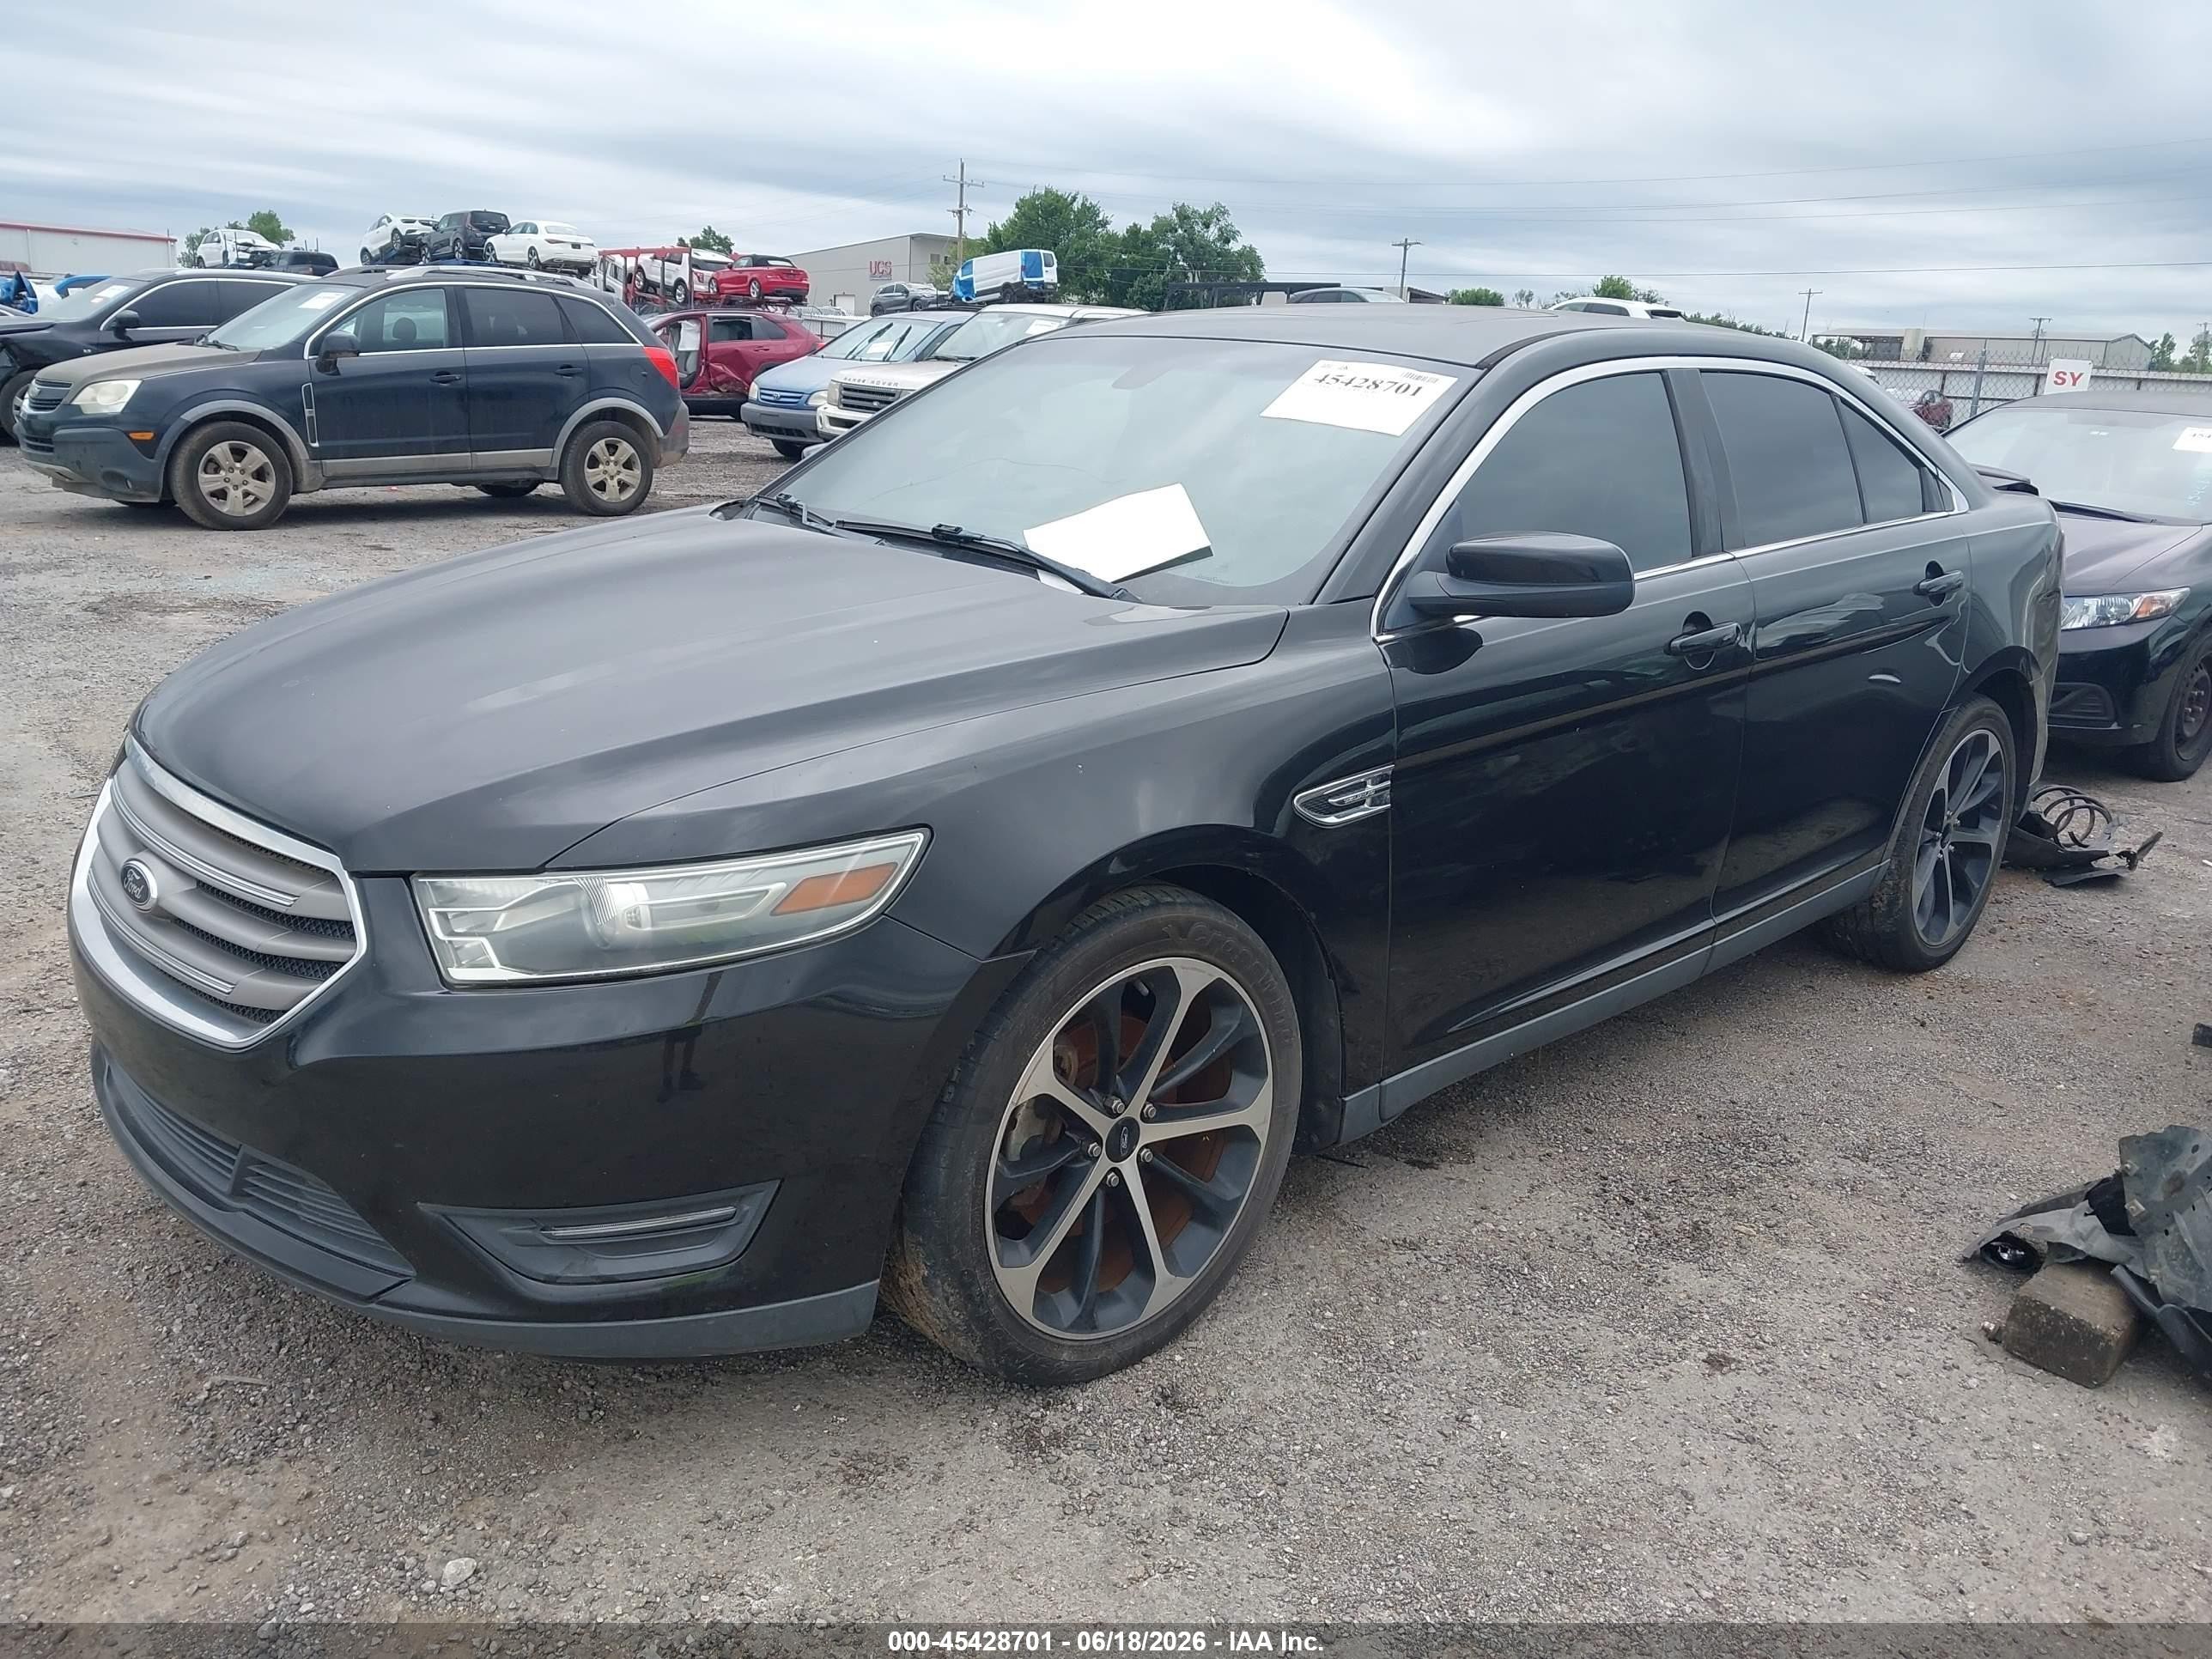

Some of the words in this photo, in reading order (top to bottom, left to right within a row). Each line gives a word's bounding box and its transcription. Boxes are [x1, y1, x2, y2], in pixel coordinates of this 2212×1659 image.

[869, 260, 892, 275] UCS
[1314, 374, 1423, 397] 45428701
[2053, 371, 2084, 386] SY
[124, 868, 145, 899] Ford
